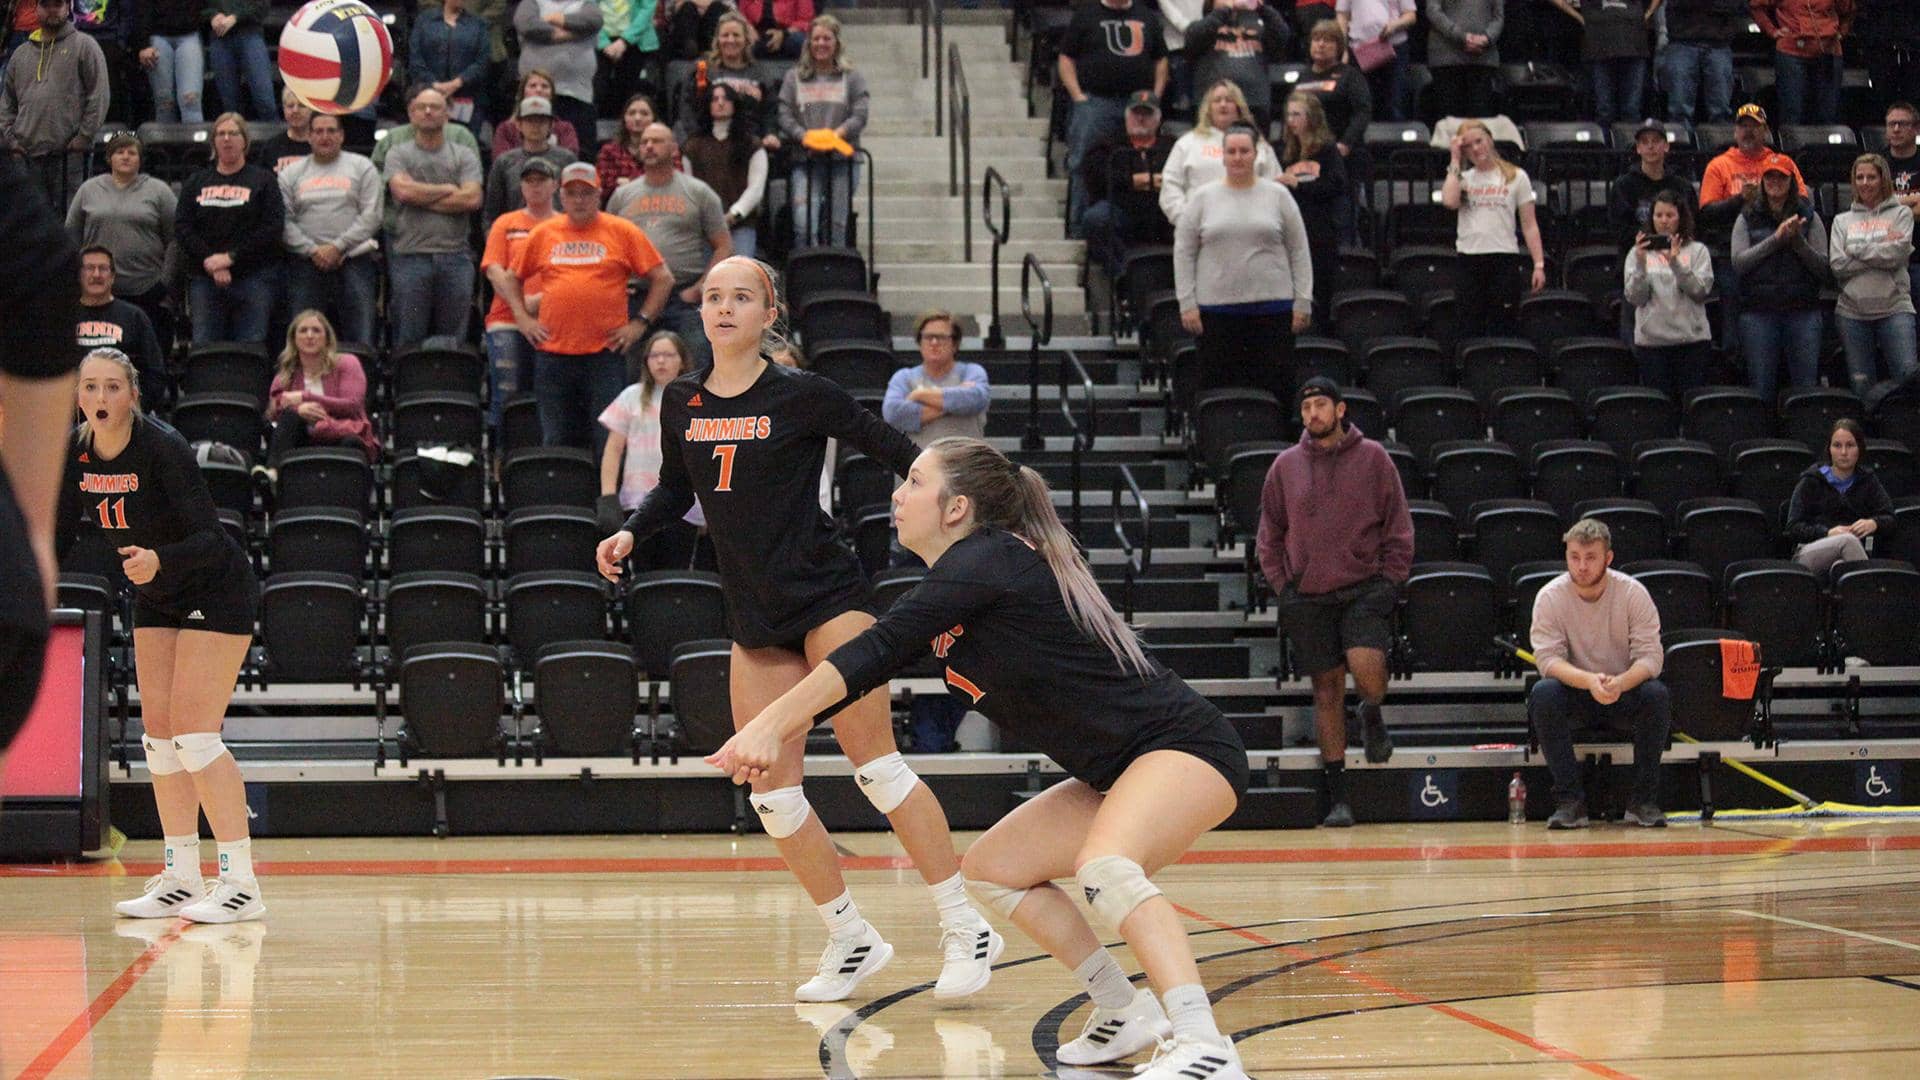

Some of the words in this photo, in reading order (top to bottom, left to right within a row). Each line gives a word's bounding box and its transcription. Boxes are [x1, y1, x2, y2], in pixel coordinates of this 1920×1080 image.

[684, 415, 771, 442] JIMMIES
[79, 472, 139, 493] JIMMIES
[711, 444, 738, 492] 7
[95, 496, 130, 529] 11
